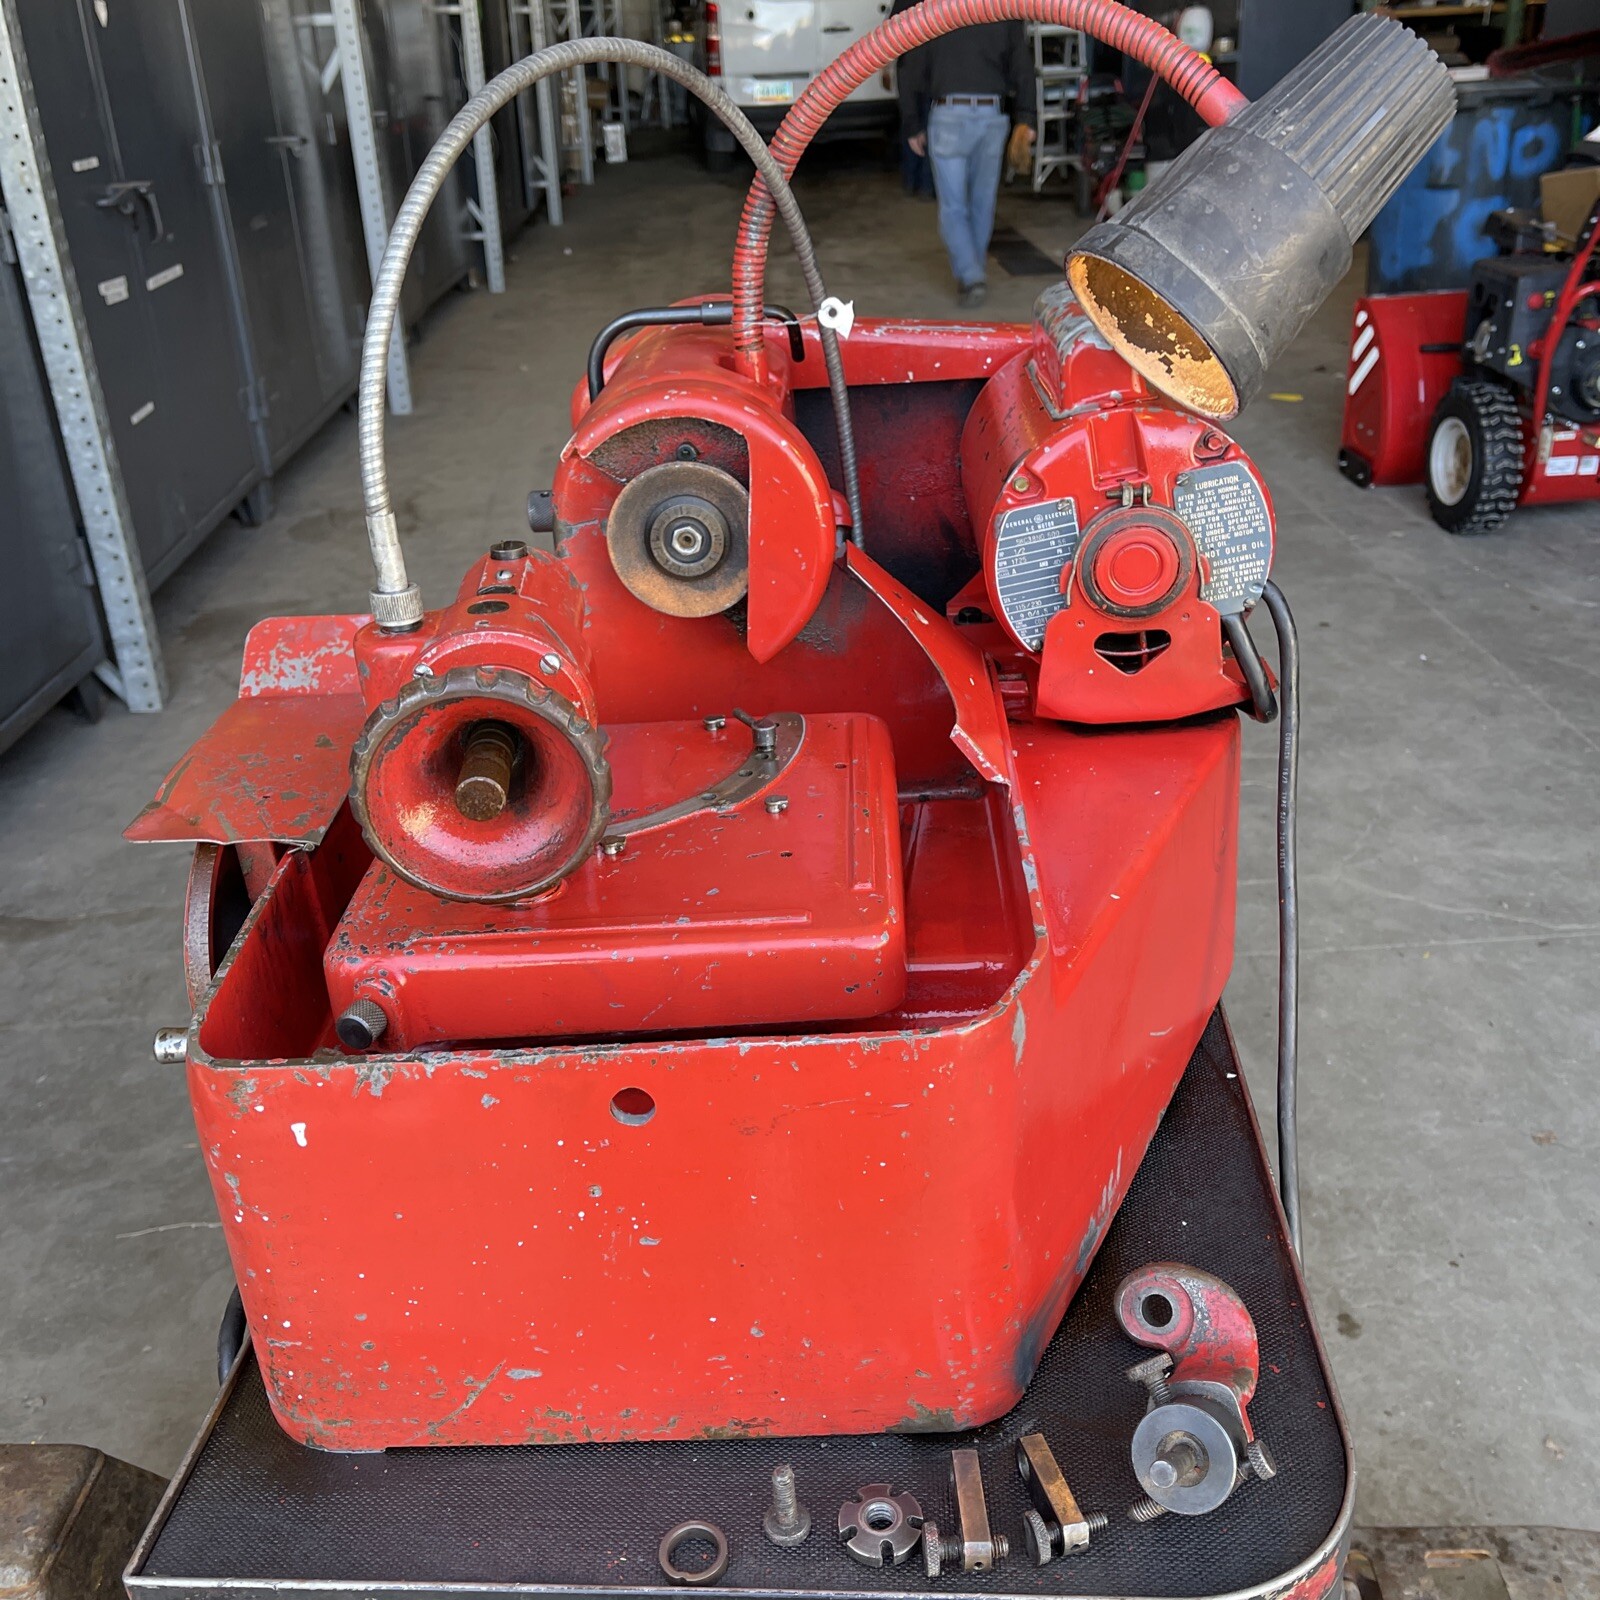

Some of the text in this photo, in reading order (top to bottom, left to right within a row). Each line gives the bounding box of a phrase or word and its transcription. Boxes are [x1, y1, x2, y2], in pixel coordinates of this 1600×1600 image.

[1195, 475, 1239, 490] LUBRICATION
[1178, 494, 1194, 502] AFTER
[1218, 485, 1240, 494] NORMAL
[1198, 496, 1216, 505] HEAVY
[1218, 503, 1246, 514] NORMALLY
[1224, 511, 1241, 520] LIGHT
[1245, 507, 1260, 515] DUTY
[1006, 518, 1032, 528] GENERAL
[1045, 509, 1072, 520] ELECTRIC
[1038, 521, 1054, 529] MOTOR
[1206, 522, 1223, 530] TOTAL
[1228, 513, 1264, 525] OPERATING
[1205, 534, 1230, 543] ELECTRIC
[1234, 528, 1253, 538] MOTOR
[1206, 527, 1224, 536] UNDER
[1205, 549, 1220, 558] NOT
[1225, 544, 1247, 554] OVER
[1213, 553, 1256, 567] DISASSEMBLE
[1213, 560, 1265, 575] REMOVE BEARING
[1232, 567, 1264, 577] TERMINAL
[1234, 573, 1261, 583] REMOVE
